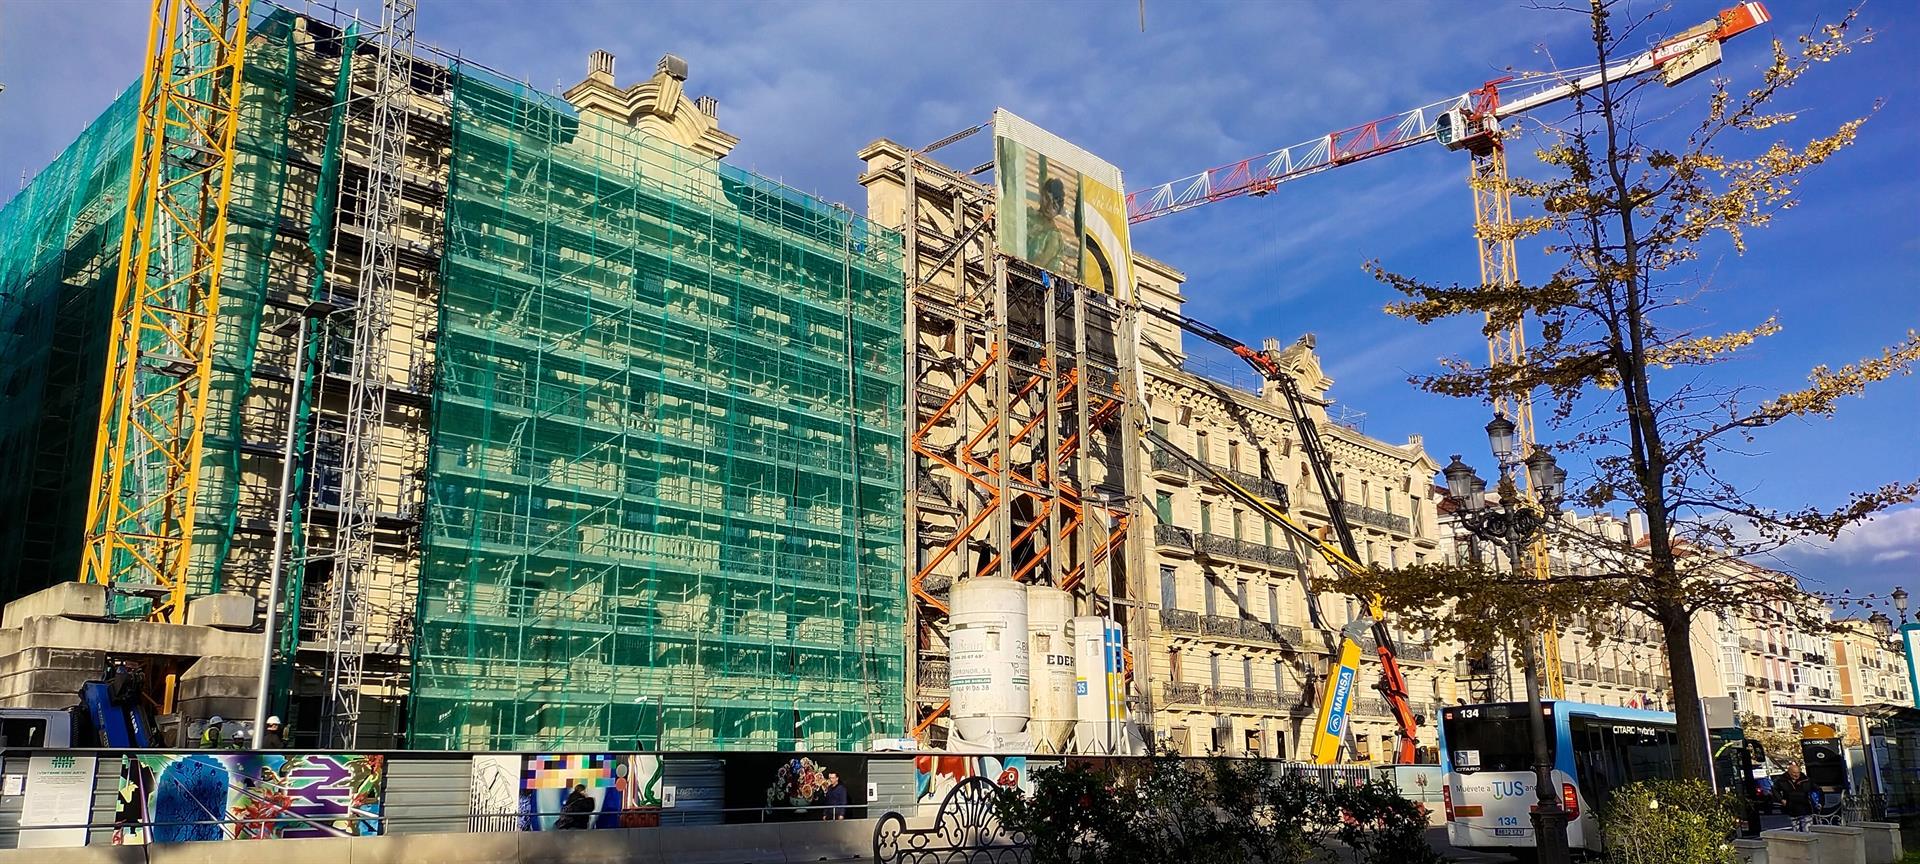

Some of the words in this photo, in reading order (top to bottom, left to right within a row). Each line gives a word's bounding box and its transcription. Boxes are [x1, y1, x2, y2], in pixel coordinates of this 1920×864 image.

[1077, 682, 1085, 693] 35
[1333, 672, 1350, 711] MAINSA
[1460, 708, 1479, 718] 134
[1612, 725, 1636, 734] CITARO
[1636, 726, 1655, 737] hybrid
[1456, 784, 1485, 792] Muévete
[1492, 781, 1524, 797] TUS
[1497, 816, 1518, 826] 134
